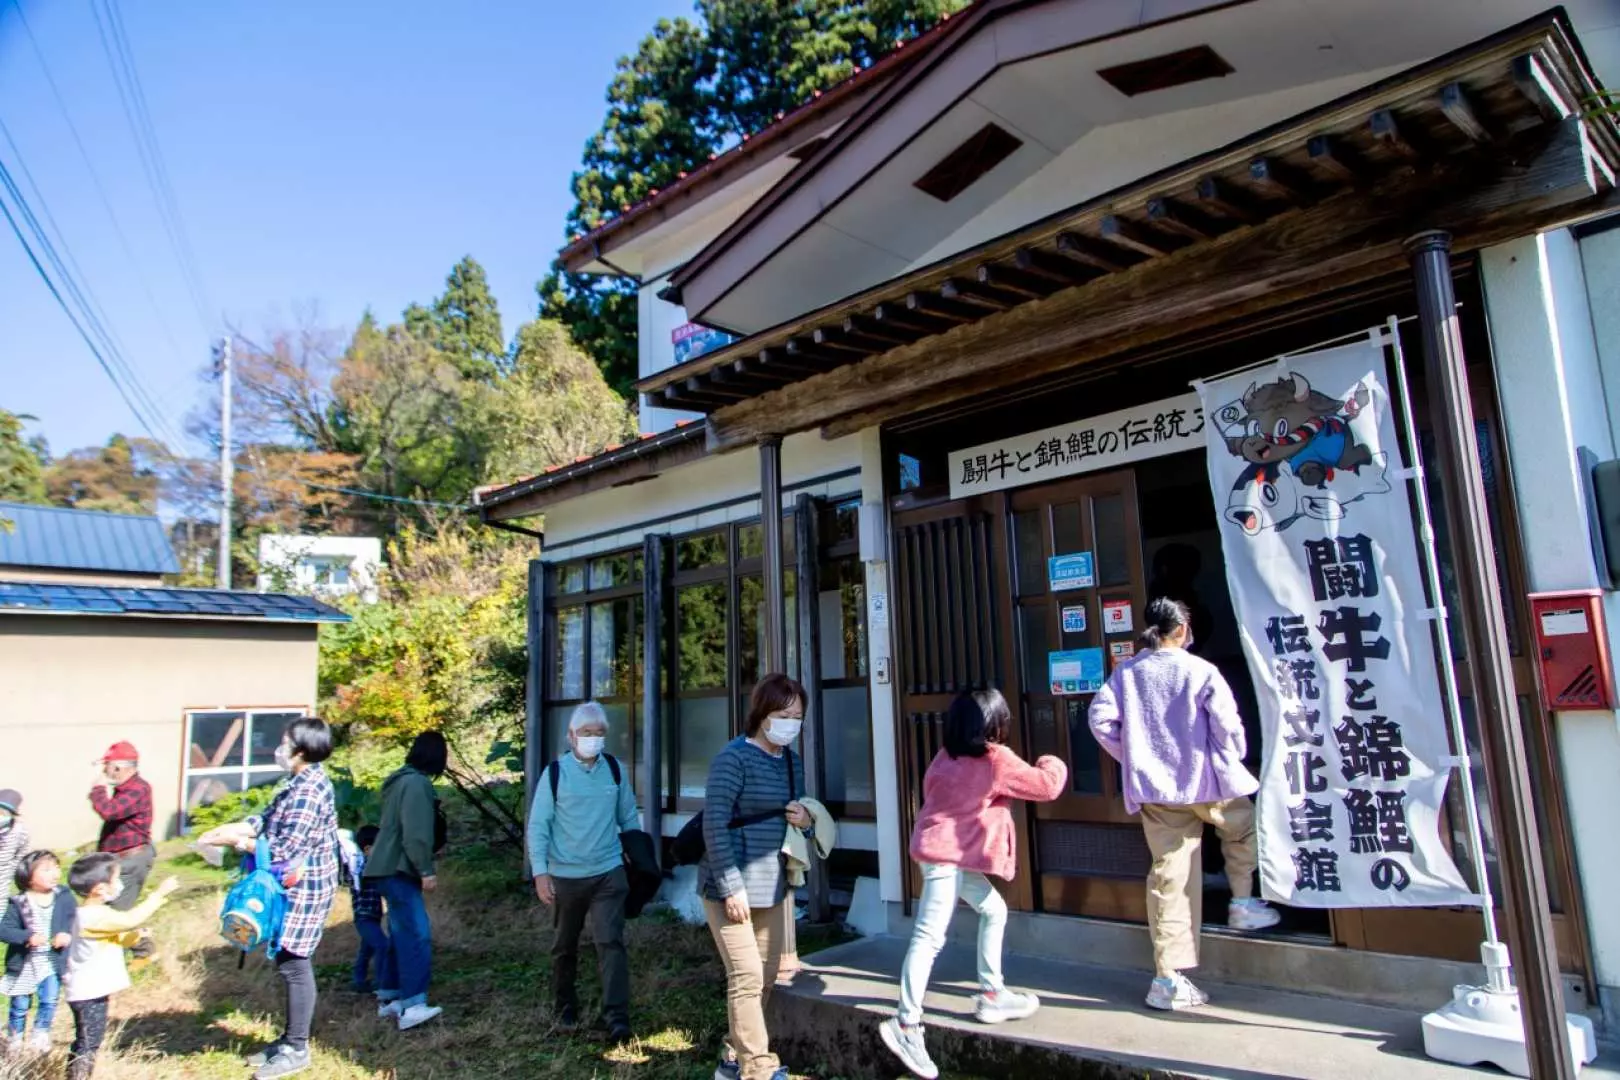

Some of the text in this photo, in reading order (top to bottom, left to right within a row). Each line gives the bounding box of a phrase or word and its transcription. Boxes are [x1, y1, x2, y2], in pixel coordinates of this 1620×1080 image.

[1264, 614, 1341, 893] 伝統文化会館
[1303, 532, 1414, 892] 闘牛と錦鯉の
